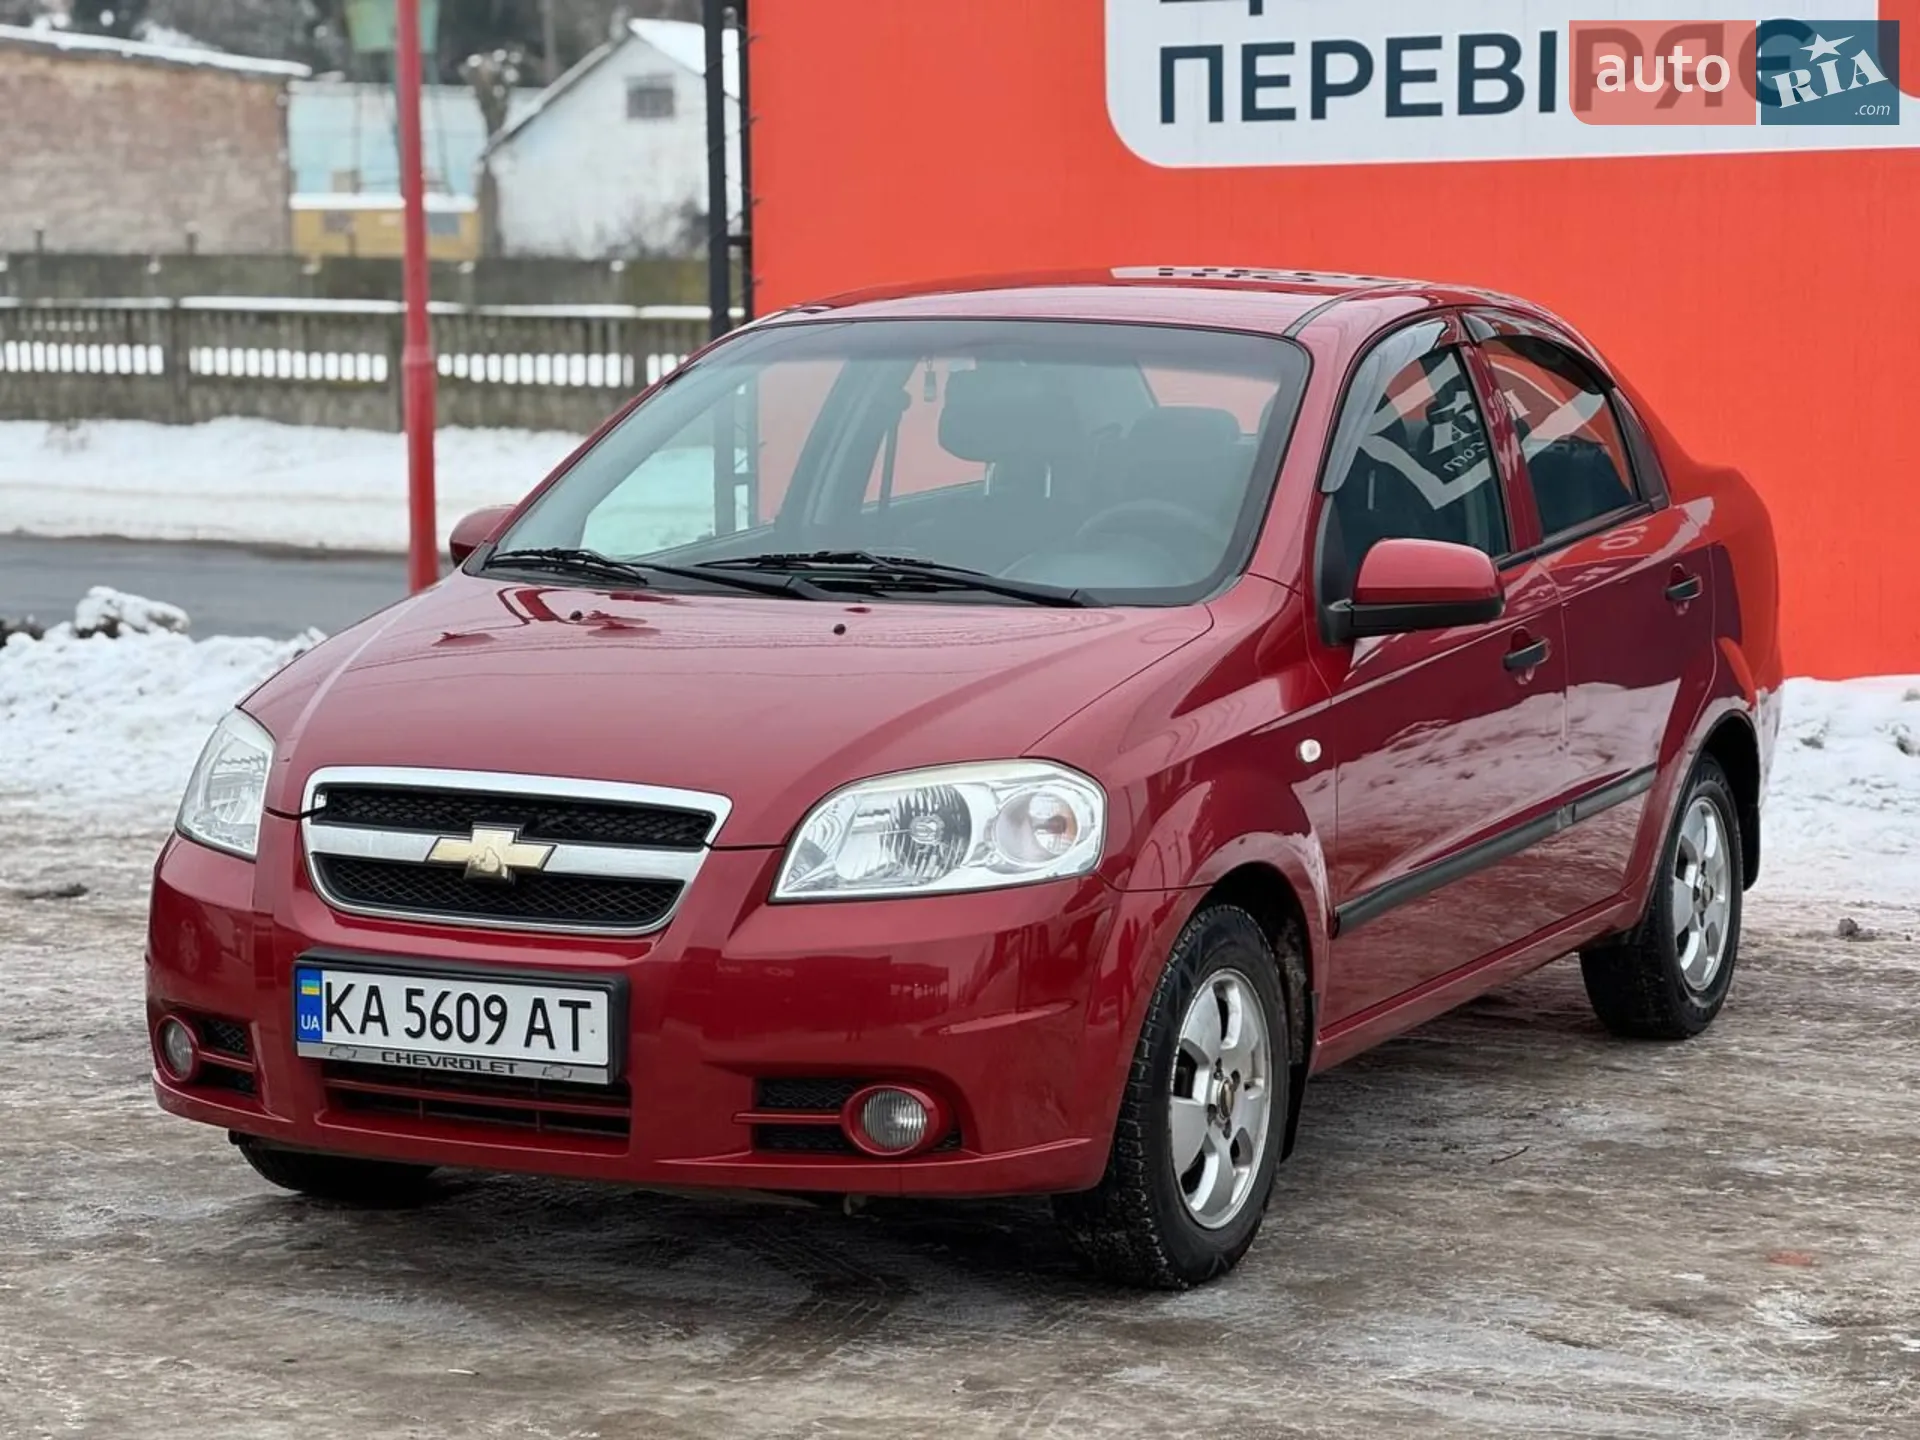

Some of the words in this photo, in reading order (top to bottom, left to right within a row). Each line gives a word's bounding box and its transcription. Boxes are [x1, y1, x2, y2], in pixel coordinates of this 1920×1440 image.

[301, 1014, 321, 1032] UA
[325, 981, 389, 1037] KA
[404, 988, 508, 1045] 5609
[523, 997, 592, 1052] AT
[381, 1051, 519, 1075] CHEVROLET
